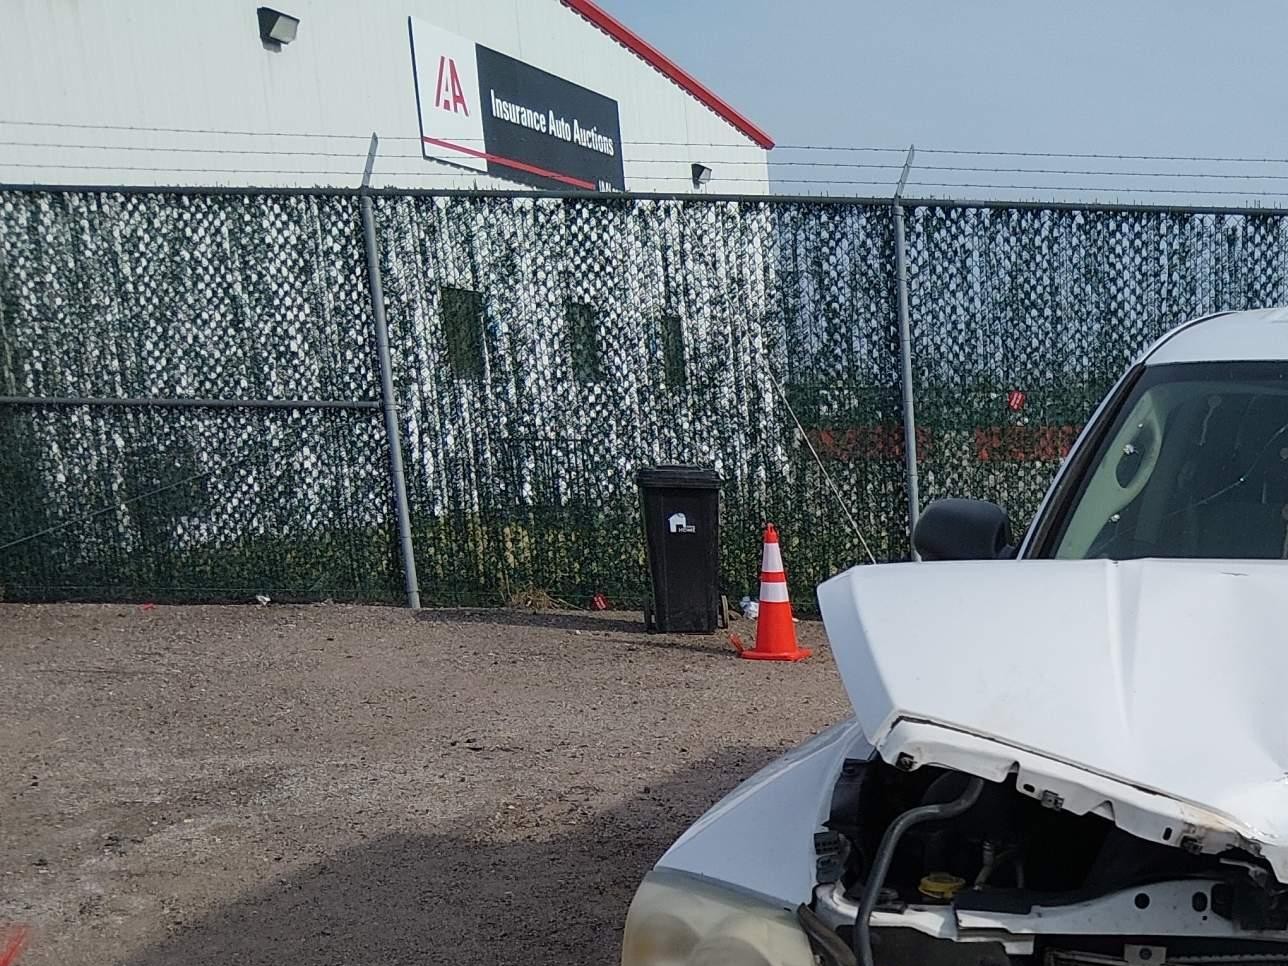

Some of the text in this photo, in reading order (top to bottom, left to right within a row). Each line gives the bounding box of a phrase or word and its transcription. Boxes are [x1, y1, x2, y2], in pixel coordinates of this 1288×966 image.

[490, 89, 614, 157] Insurance Auto Auctions
